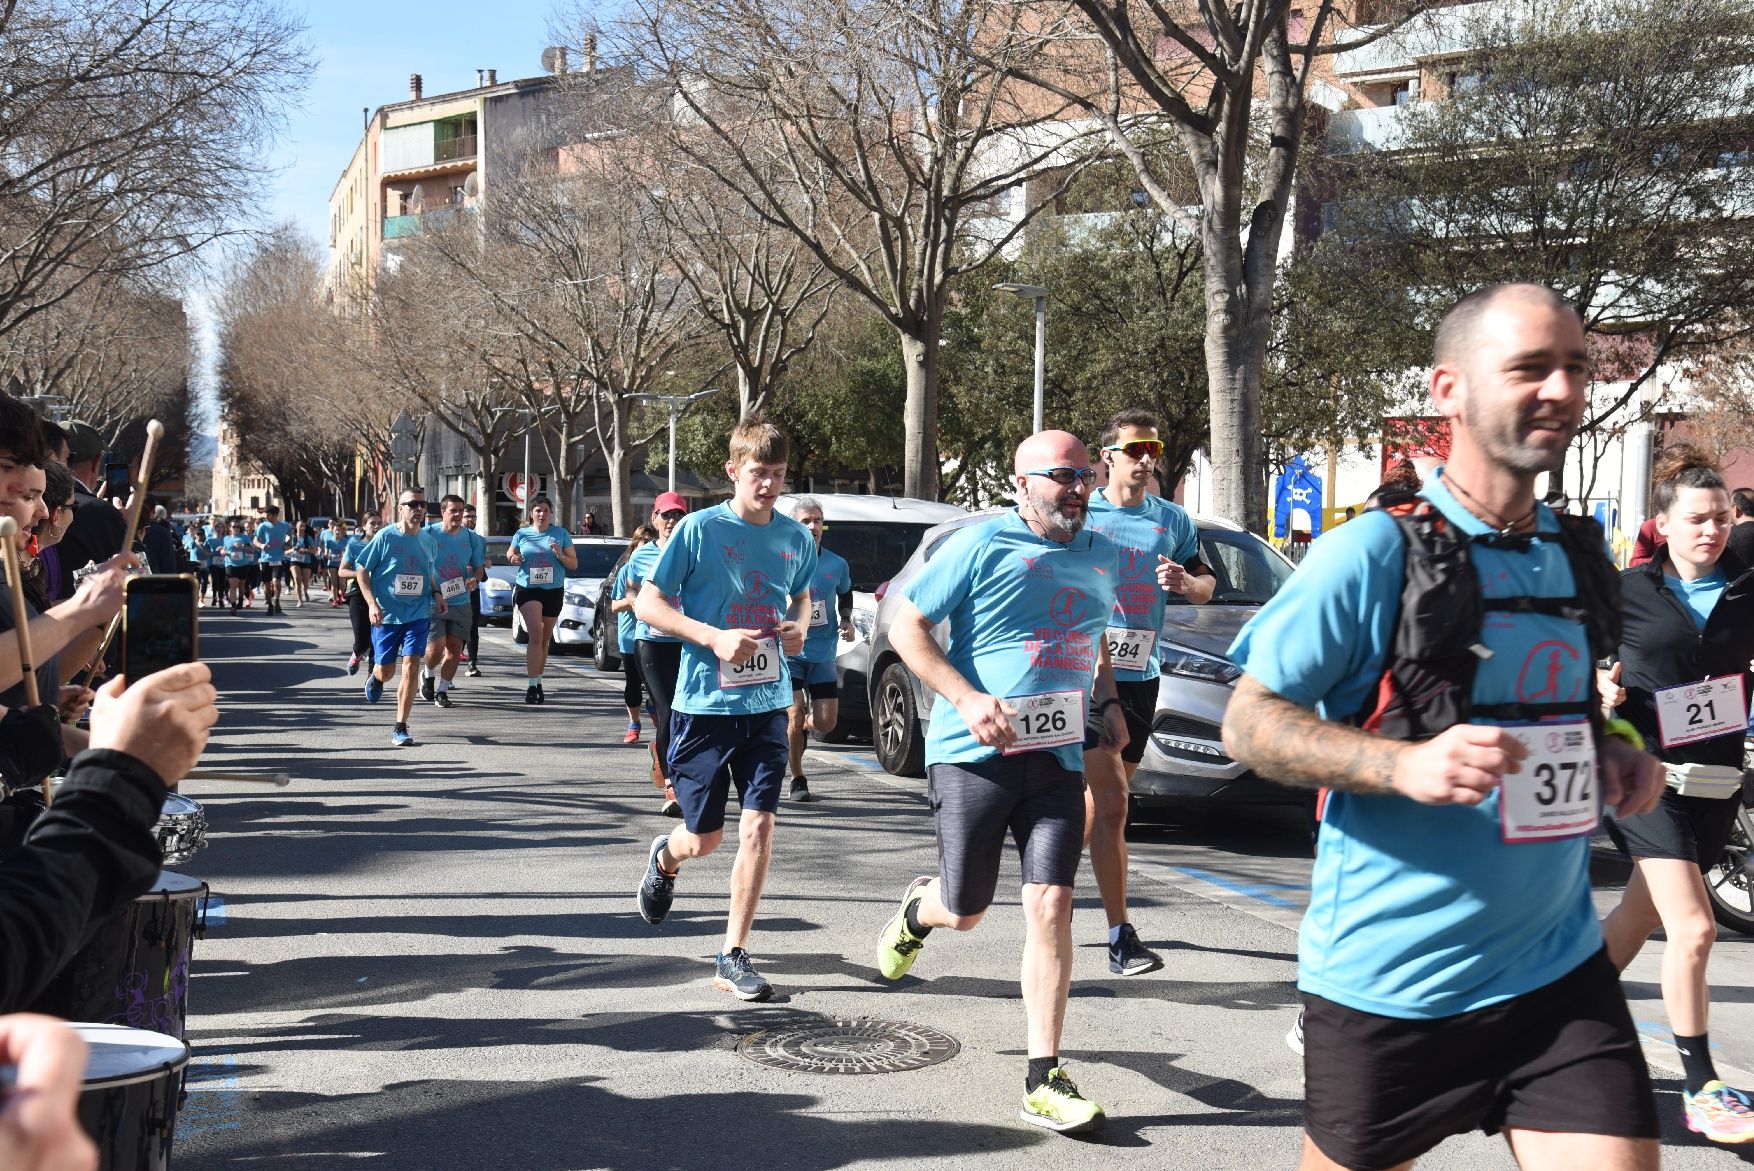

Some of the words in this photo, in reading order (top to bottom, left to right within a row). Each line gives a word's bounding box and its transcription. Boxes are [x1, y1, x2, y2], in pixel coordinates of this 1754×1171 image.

[401, 581, 419, 590] 587
[446, 583, 461, 592] 468
[1053, 631, 1092, 645] CURSA
[1024, 640, 1044, 653] DE
[1046, 643, 1064, 656] LA
[1066, 644, 1095, 658] DONA
[1108, 641, 1140, 658] 284
[1030, 655, 1092, 672] MANRESA
[1686, 700, 1716, 726] 21
[1019, 709, 1067, 735] 126
[1534, 761, 1592, 806] 372
